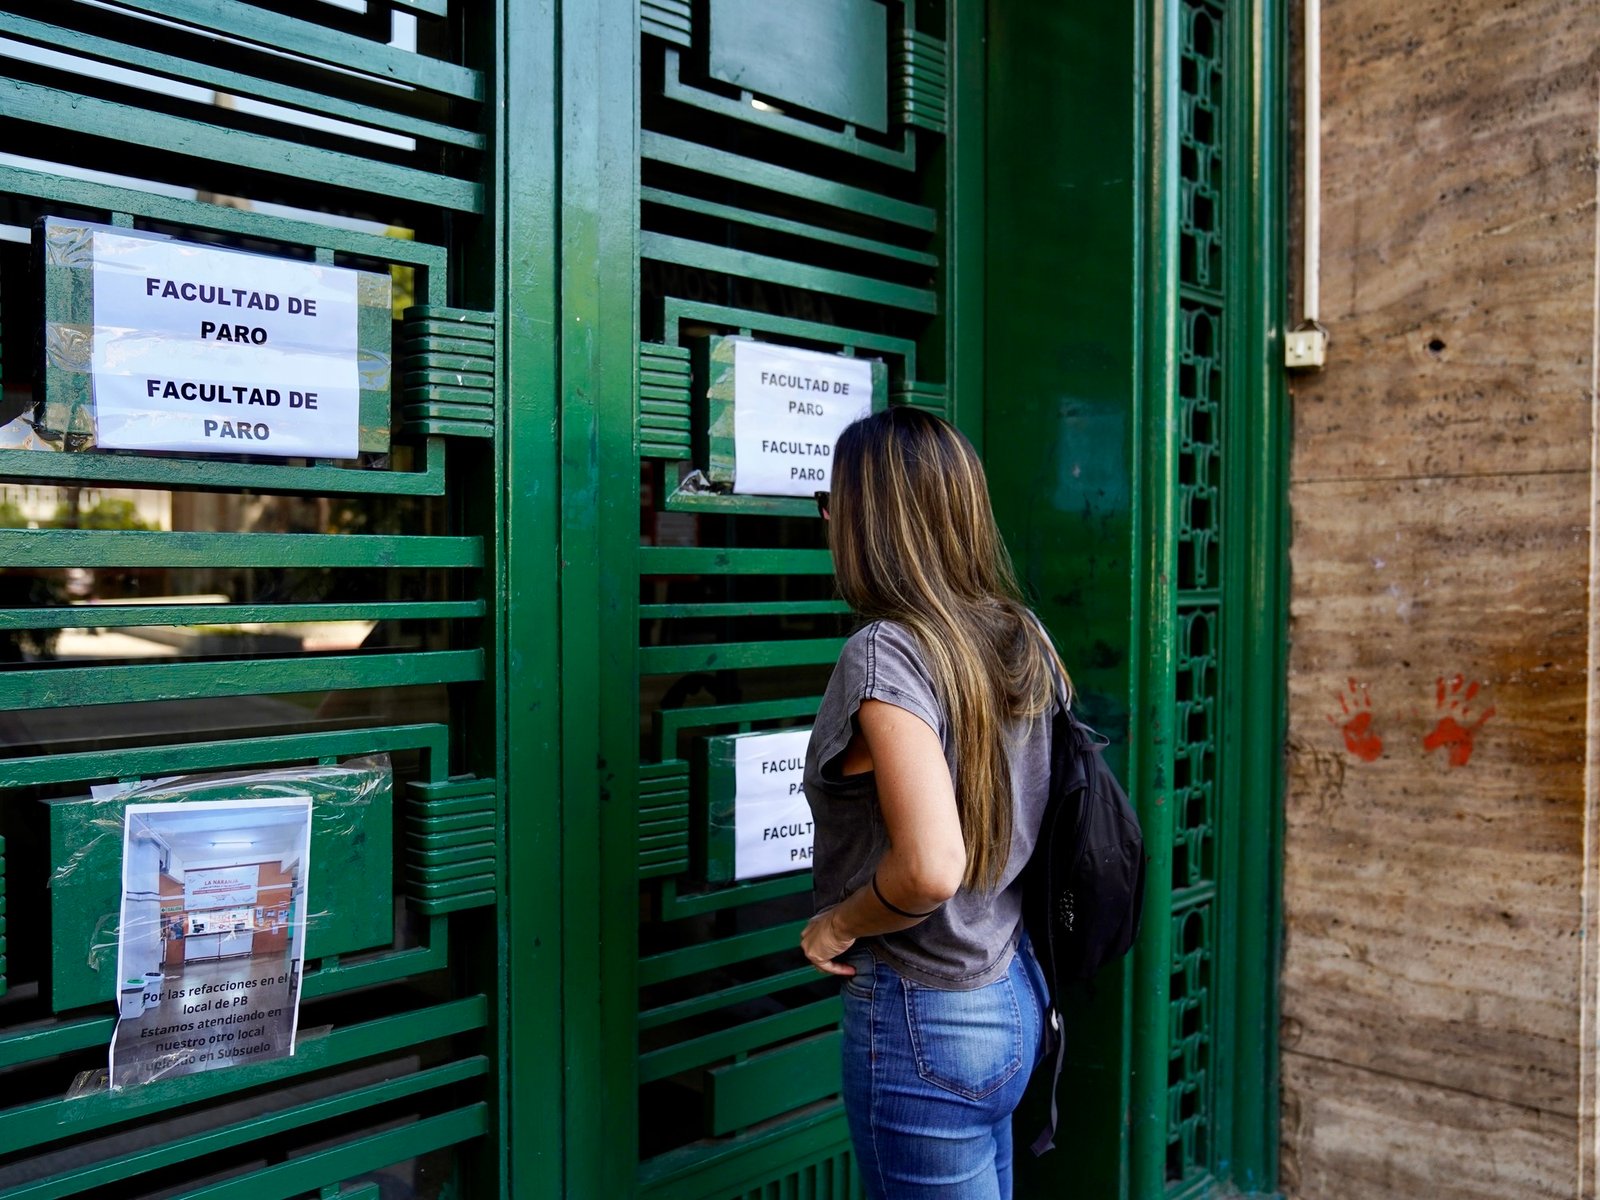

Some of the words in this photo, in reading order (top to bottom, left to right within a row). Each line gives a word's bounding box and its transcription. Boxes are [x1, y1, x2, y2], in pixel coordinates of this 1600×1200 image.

[145, 277, 280, 312] FACULTAD
[287, 297, 317, 317] DE
[200, 321, 268, 345] PARO
[146, 379, 281, 408] FACULTAD
[289, 391, 318, 410] DE
[760, 372, 830, 393] FACULTAD
[833, 381, 850, 395] DE
[788, 401, 824, 416] PARO
[204, 419, 271, 441] PARO
[761, 439, 831, 457] FACULTAD
[790, 467, 825, 481] PARO
[763, 821, 813, 841] FACULT
[142, 992, 164, 1003] Por
[168, 988, 185, 1000] las
[188, 979, 257, 997] refacciones
[260, 976, 275, 986] en
[278, 973, 288, 983] el
[183, 1000, 211, 1015] local
[215, 998, 230, 1009] de
[233, 995, 248, 1007] PB
[140, 1022, 194, 1038] Estamos
[197, 1010, 265, 1030] atendiendo
[268, 1008, 282, 1018] en
[155, 1035, 206, 1052] nuestro
[208, 1030, 234, 1044] otro
[237, 1026, 265, 1040] local
[199, 1051, 214, 1062] en
[218, 1042, 271, 1059] Subsuelo
